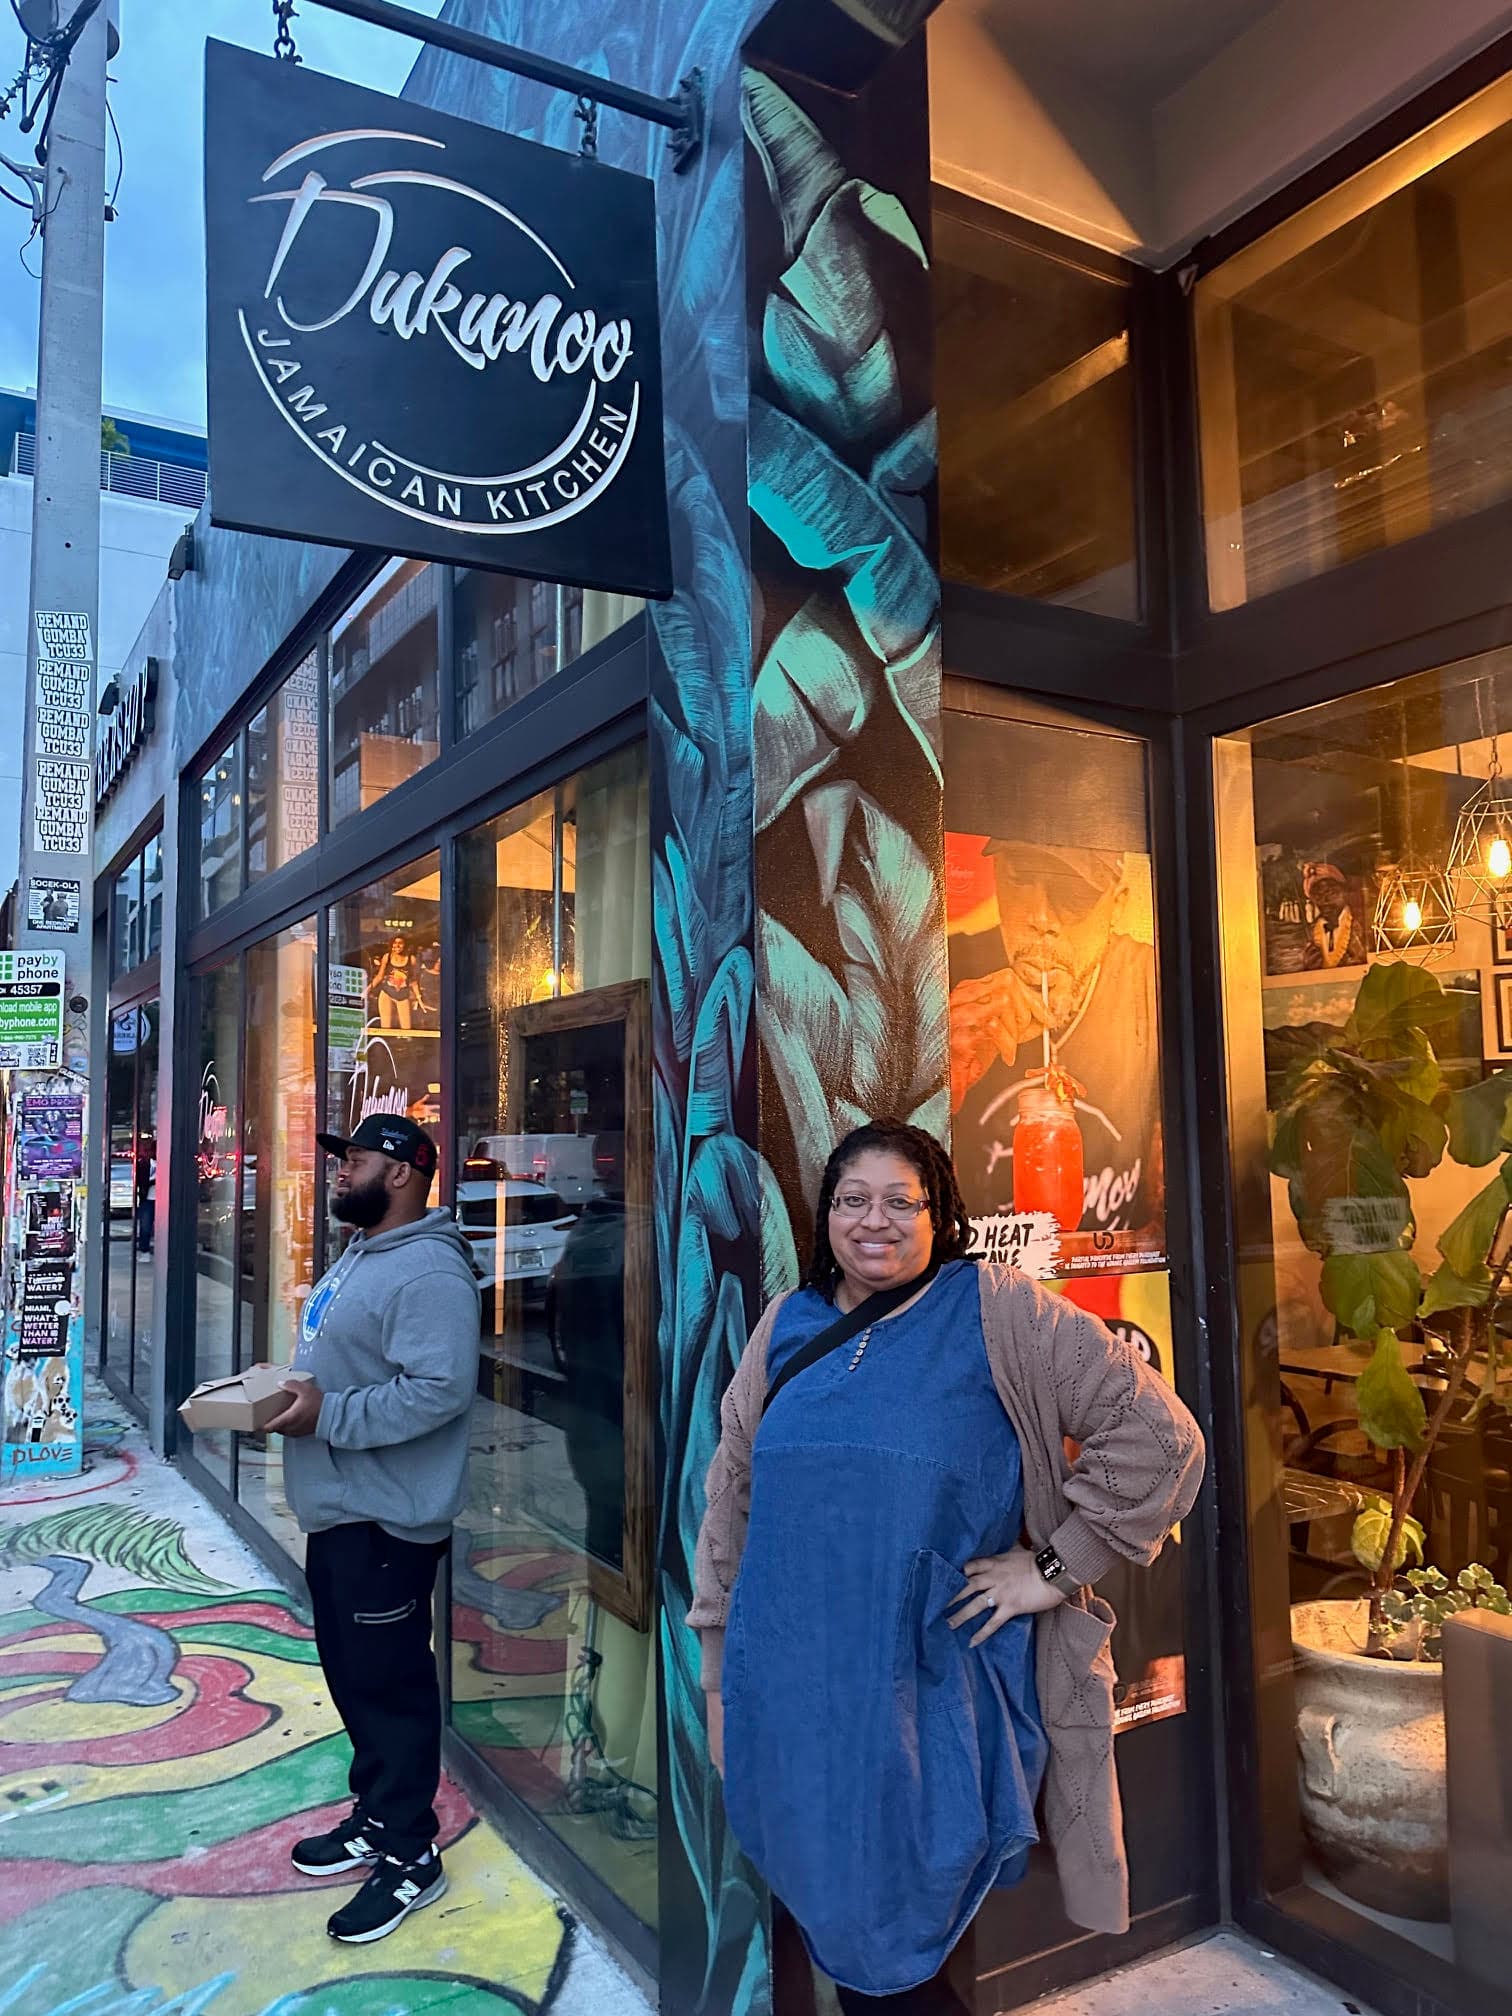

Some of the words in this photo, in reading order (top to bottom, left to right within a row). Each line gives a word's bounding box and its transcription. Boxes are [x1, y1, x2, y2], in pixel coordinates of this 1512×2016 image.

[257, 328, 463, 517] JAMAICAN
[487, 402, 630, 520] KITCHEN
[37, 613, 88, 630] REMAND
[38, 659, 89, 681] REMAND
[38, 707, 89, 729] REMAND
[38, 761, 89, 781] REMAND
[36, 806, 87, 824] REMAND
[18, 968, 59, 981] phone
[10, 984, 43, 995] 45357
[0, 1001, 17, 1012] nload
[19, 1001, 43, 1012] mobile
[43, 1003, 57, 1014] app
[0, 1017, 57, 1030] byphone.com
[26, 1098, 49, 1106] EMO
[50, 1098, 80, 1106] PROM
[985, 1223, 1034, 1248] HEAT
[27, 1284, 63, 1292] WATER?
[23, 1322, 59, 1330] WETTER
[22, 1337, 58, 1345] WATER?
